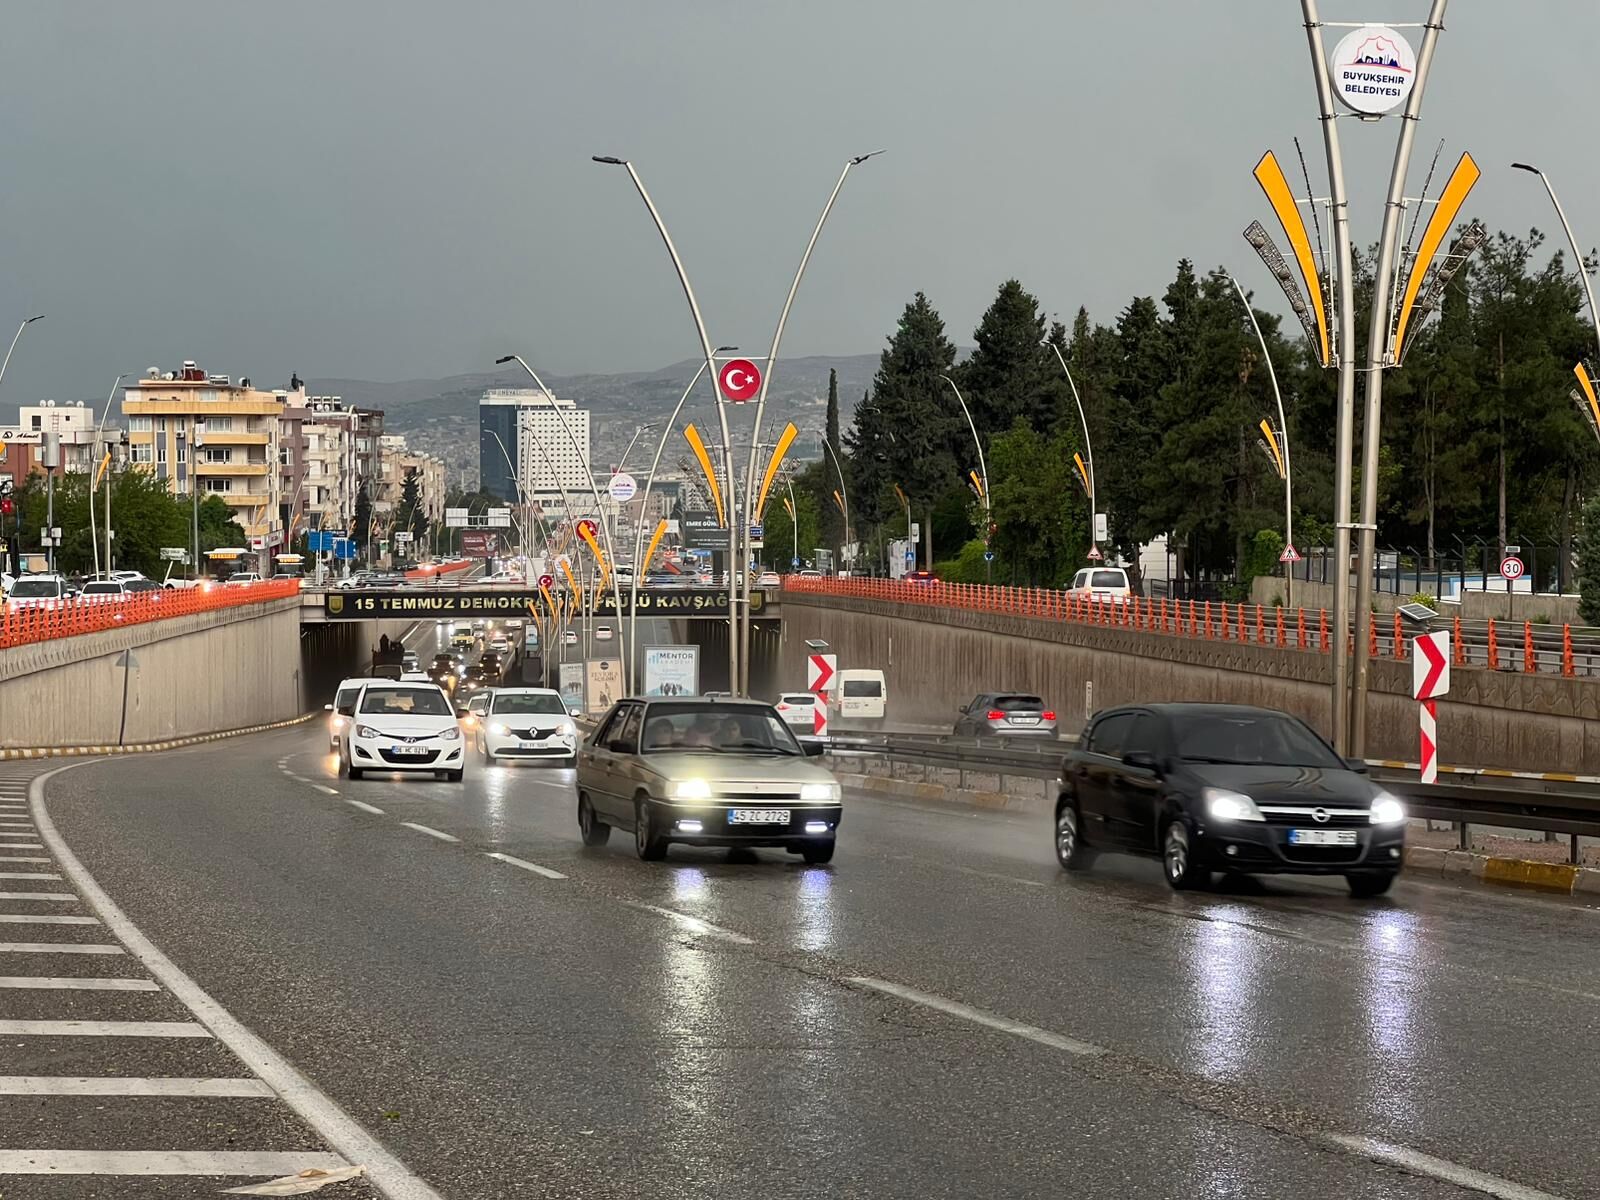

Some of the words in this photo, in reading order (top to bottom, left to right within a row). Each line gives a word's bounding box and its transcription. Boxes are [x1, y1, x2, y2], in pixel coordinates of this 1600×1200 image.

[1505, 563, 1519, 574] 30
[355, 599, 375, 610] 15
[380, 598, 455, 610] TEMMUZ
[734, 811, 746, 821] 45
[749, 811, 761, 821] ZC
[764, 811, 789, 821] 2729
